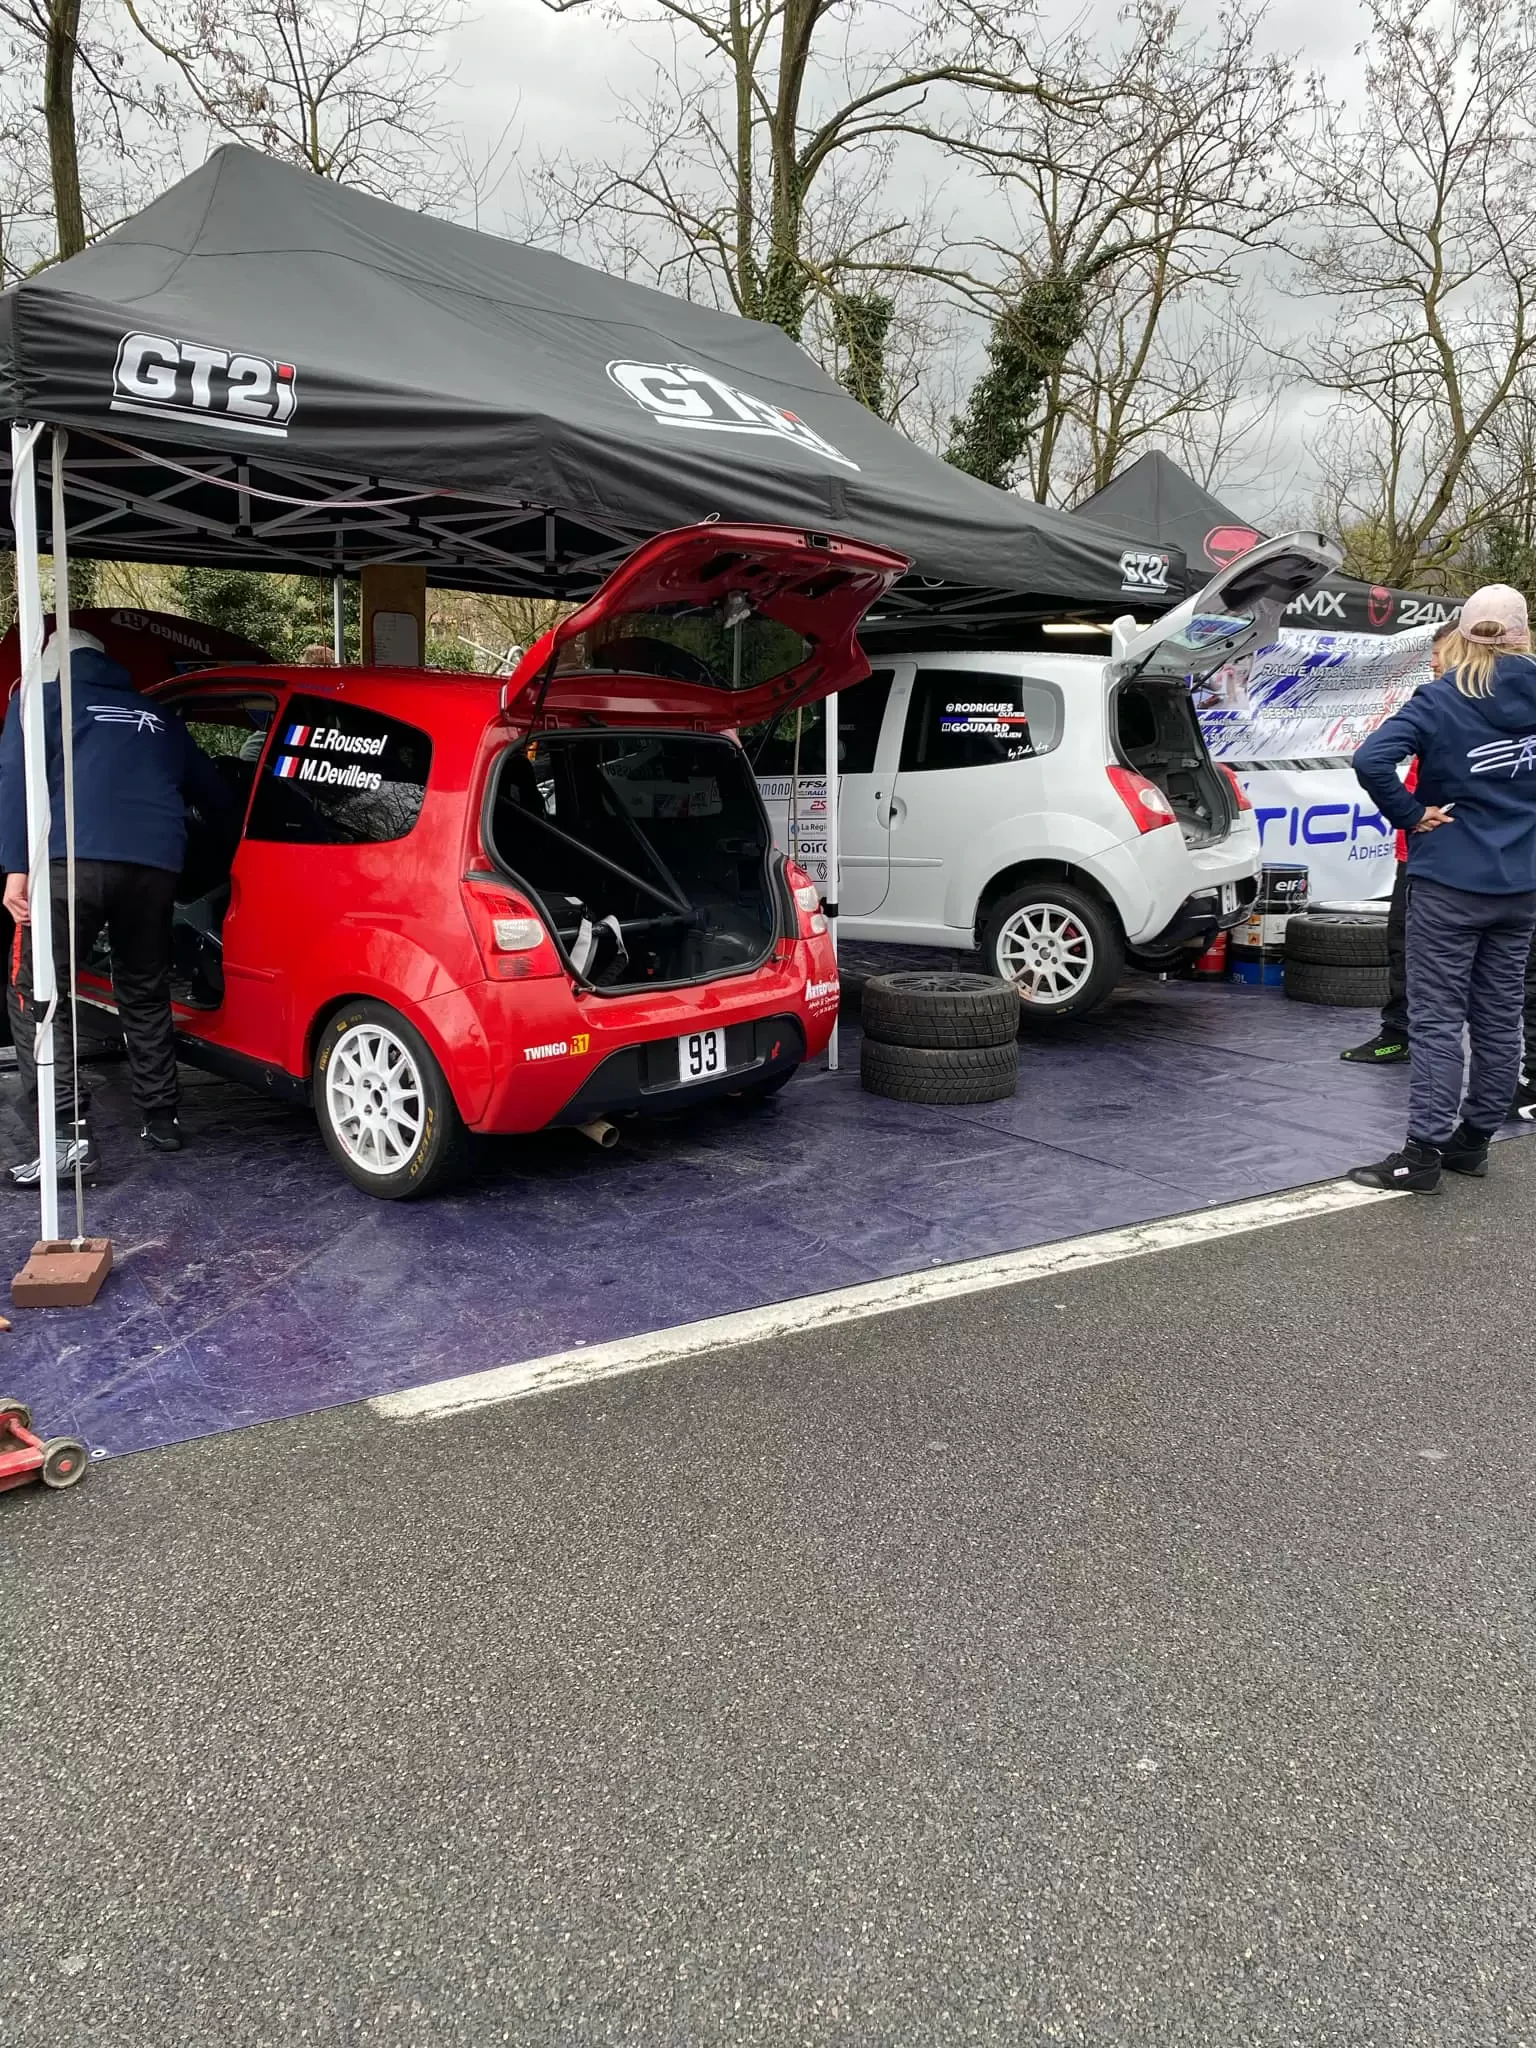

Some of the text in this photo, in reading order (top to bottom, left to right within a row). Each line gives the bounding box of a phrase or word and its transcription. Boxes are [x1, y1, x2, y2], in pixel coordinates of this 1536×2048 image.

[118, 334, 294, 421] GT2i
[1397, 599, 1465, 625] 24M
[955, 703, 1014, 713] RODRIGUES
[310, 727, 388, 756] E.Roussel
[951, 723, 1010, 733] GOUDARD
[299, 758, 382, 790] M.Devillers
[1253, 803, 1394, 847] TICK
[1275, 880, 1299, 891] elf
[524, 1035, 588, 1061] TWINGO R1
[688, 1031, 717, 1075] 93
